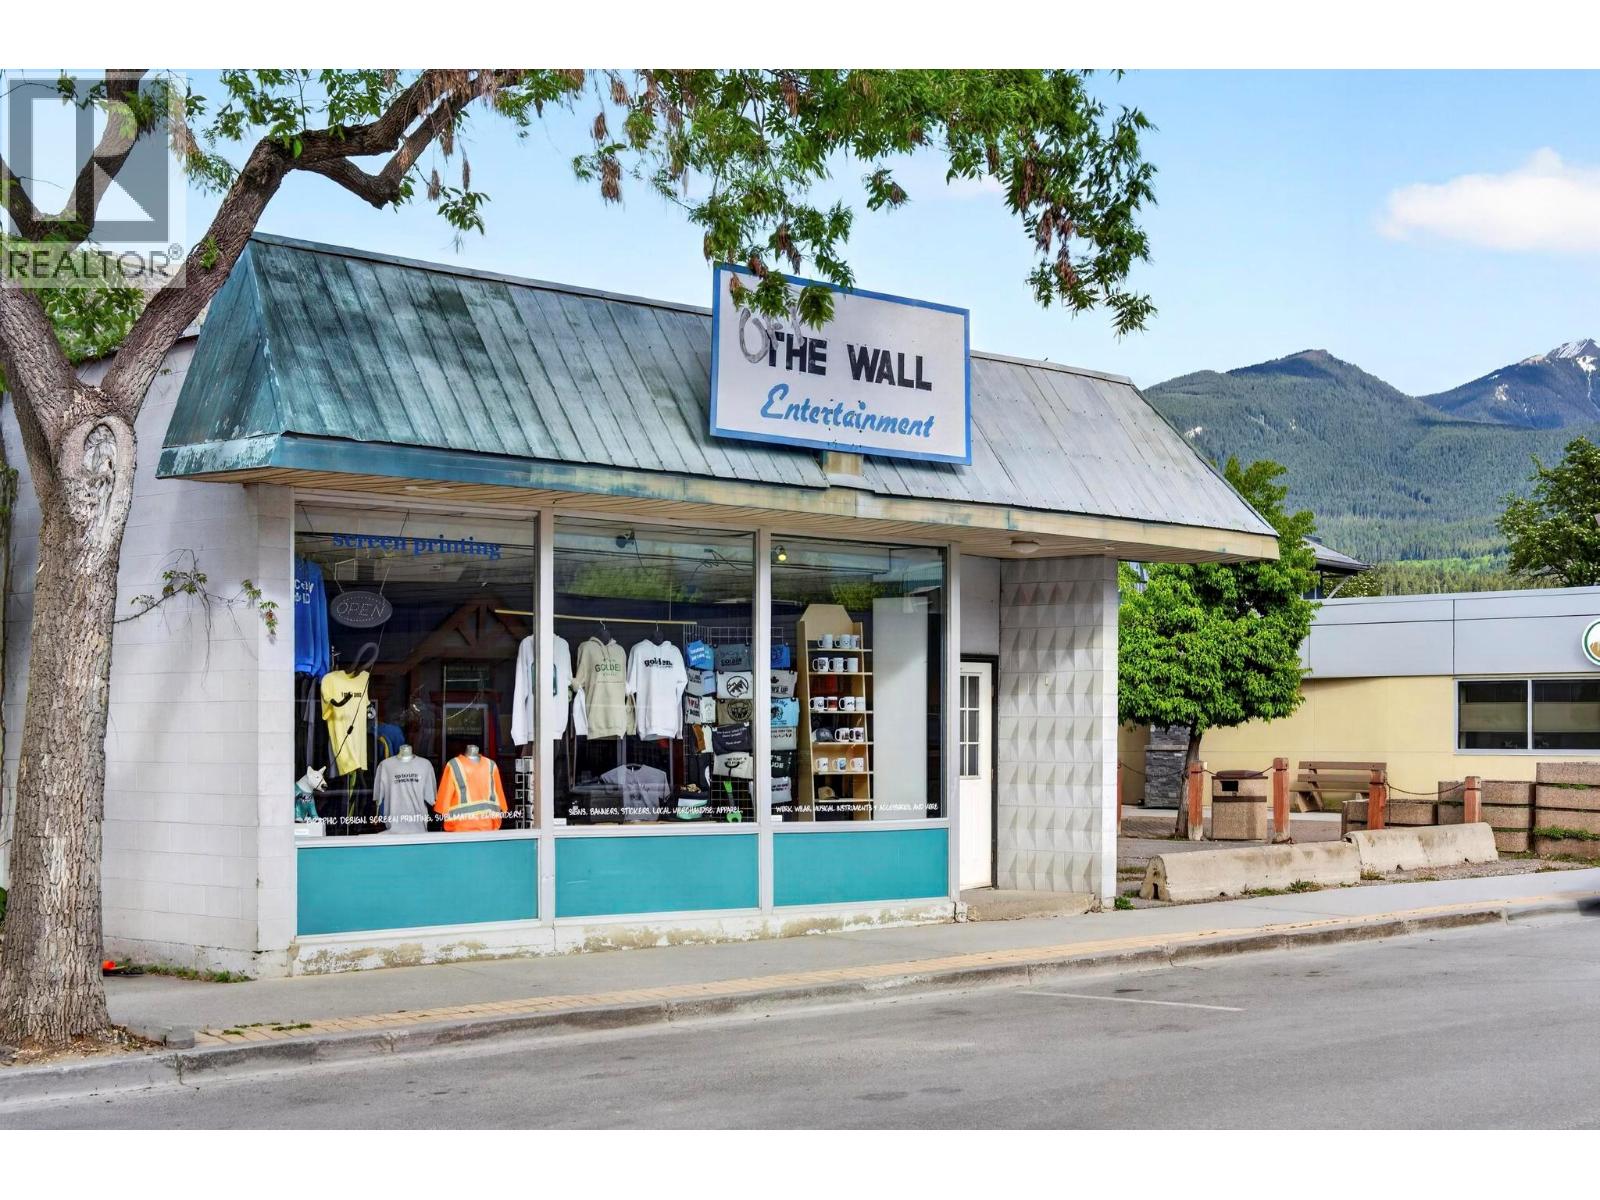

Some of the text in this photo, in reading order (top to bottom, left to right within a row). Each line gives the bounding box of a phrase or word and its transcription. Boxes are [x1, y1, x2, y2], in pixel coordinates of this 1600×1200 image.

[765, 329, 933, 392] THE WALL
[760, 383, 936, 438] Entertainment
[333, 533, 501, 561] screen printing
[336, 602, 386, 617] OPEN
[368, 814, 399, 825] SCREEN
[652, 806, 672, 815] LOCAL
